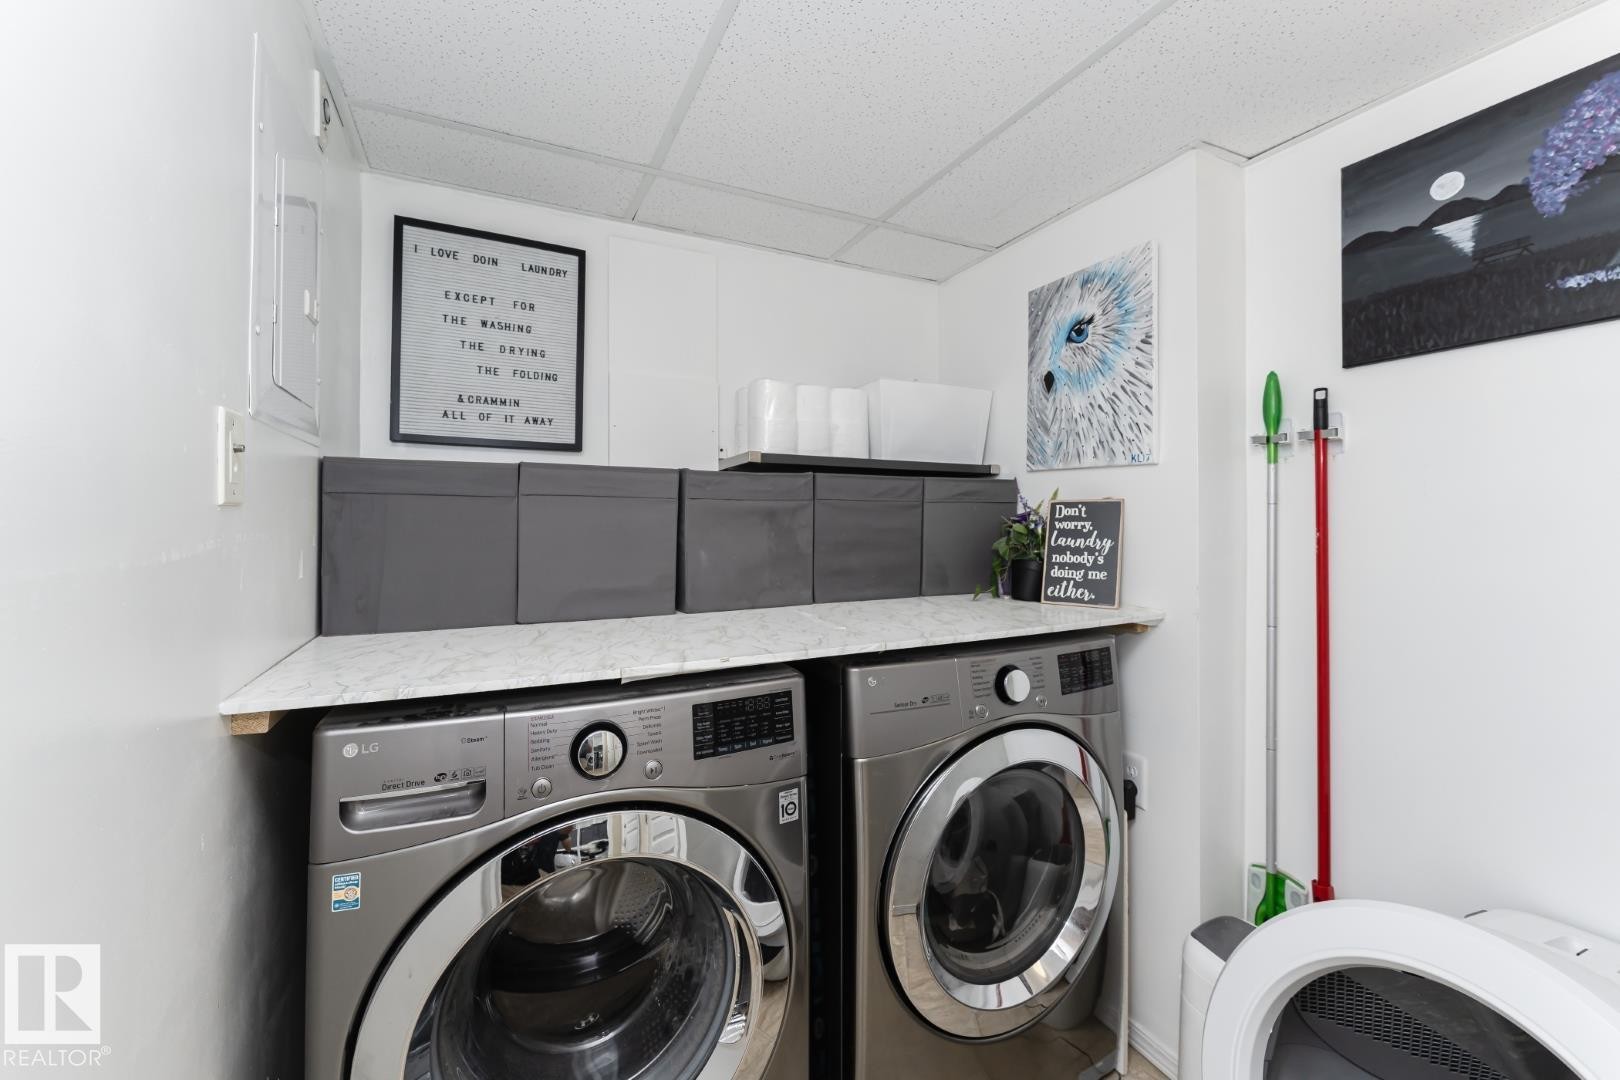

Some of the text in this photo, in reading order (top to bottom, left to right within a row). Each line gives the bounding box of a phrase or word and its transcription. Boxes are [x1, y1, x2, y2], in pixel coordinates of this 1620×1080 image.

[430, 247, 459, 260] LOVE
[473, 254, 499, 267] DOIN
[521, 263, 568, 278] LAUNDRY
[444, 290, 536, 312] EXCEPT FOR
[442, 314, 532, 334] THE WASHING
[460, 340, 546, 358] THE DRYING
[476, 365, 559, 382] THE FOLDING
[441, 409, 554, 427] ALL OF IT AWAY
[1055, 504, 1087, 518] Don't
[1051, 530, 1114, 556] laundry
[1051, 551, 1104, 567] nobody's
[1050, 566, 1108, 581] doing me
[1047, 580, 1095, 601] either.
[361, 743, 379, 754] LG
[382, 781, 404, 791] Direct
[406, 779, 426, 788] Drive
